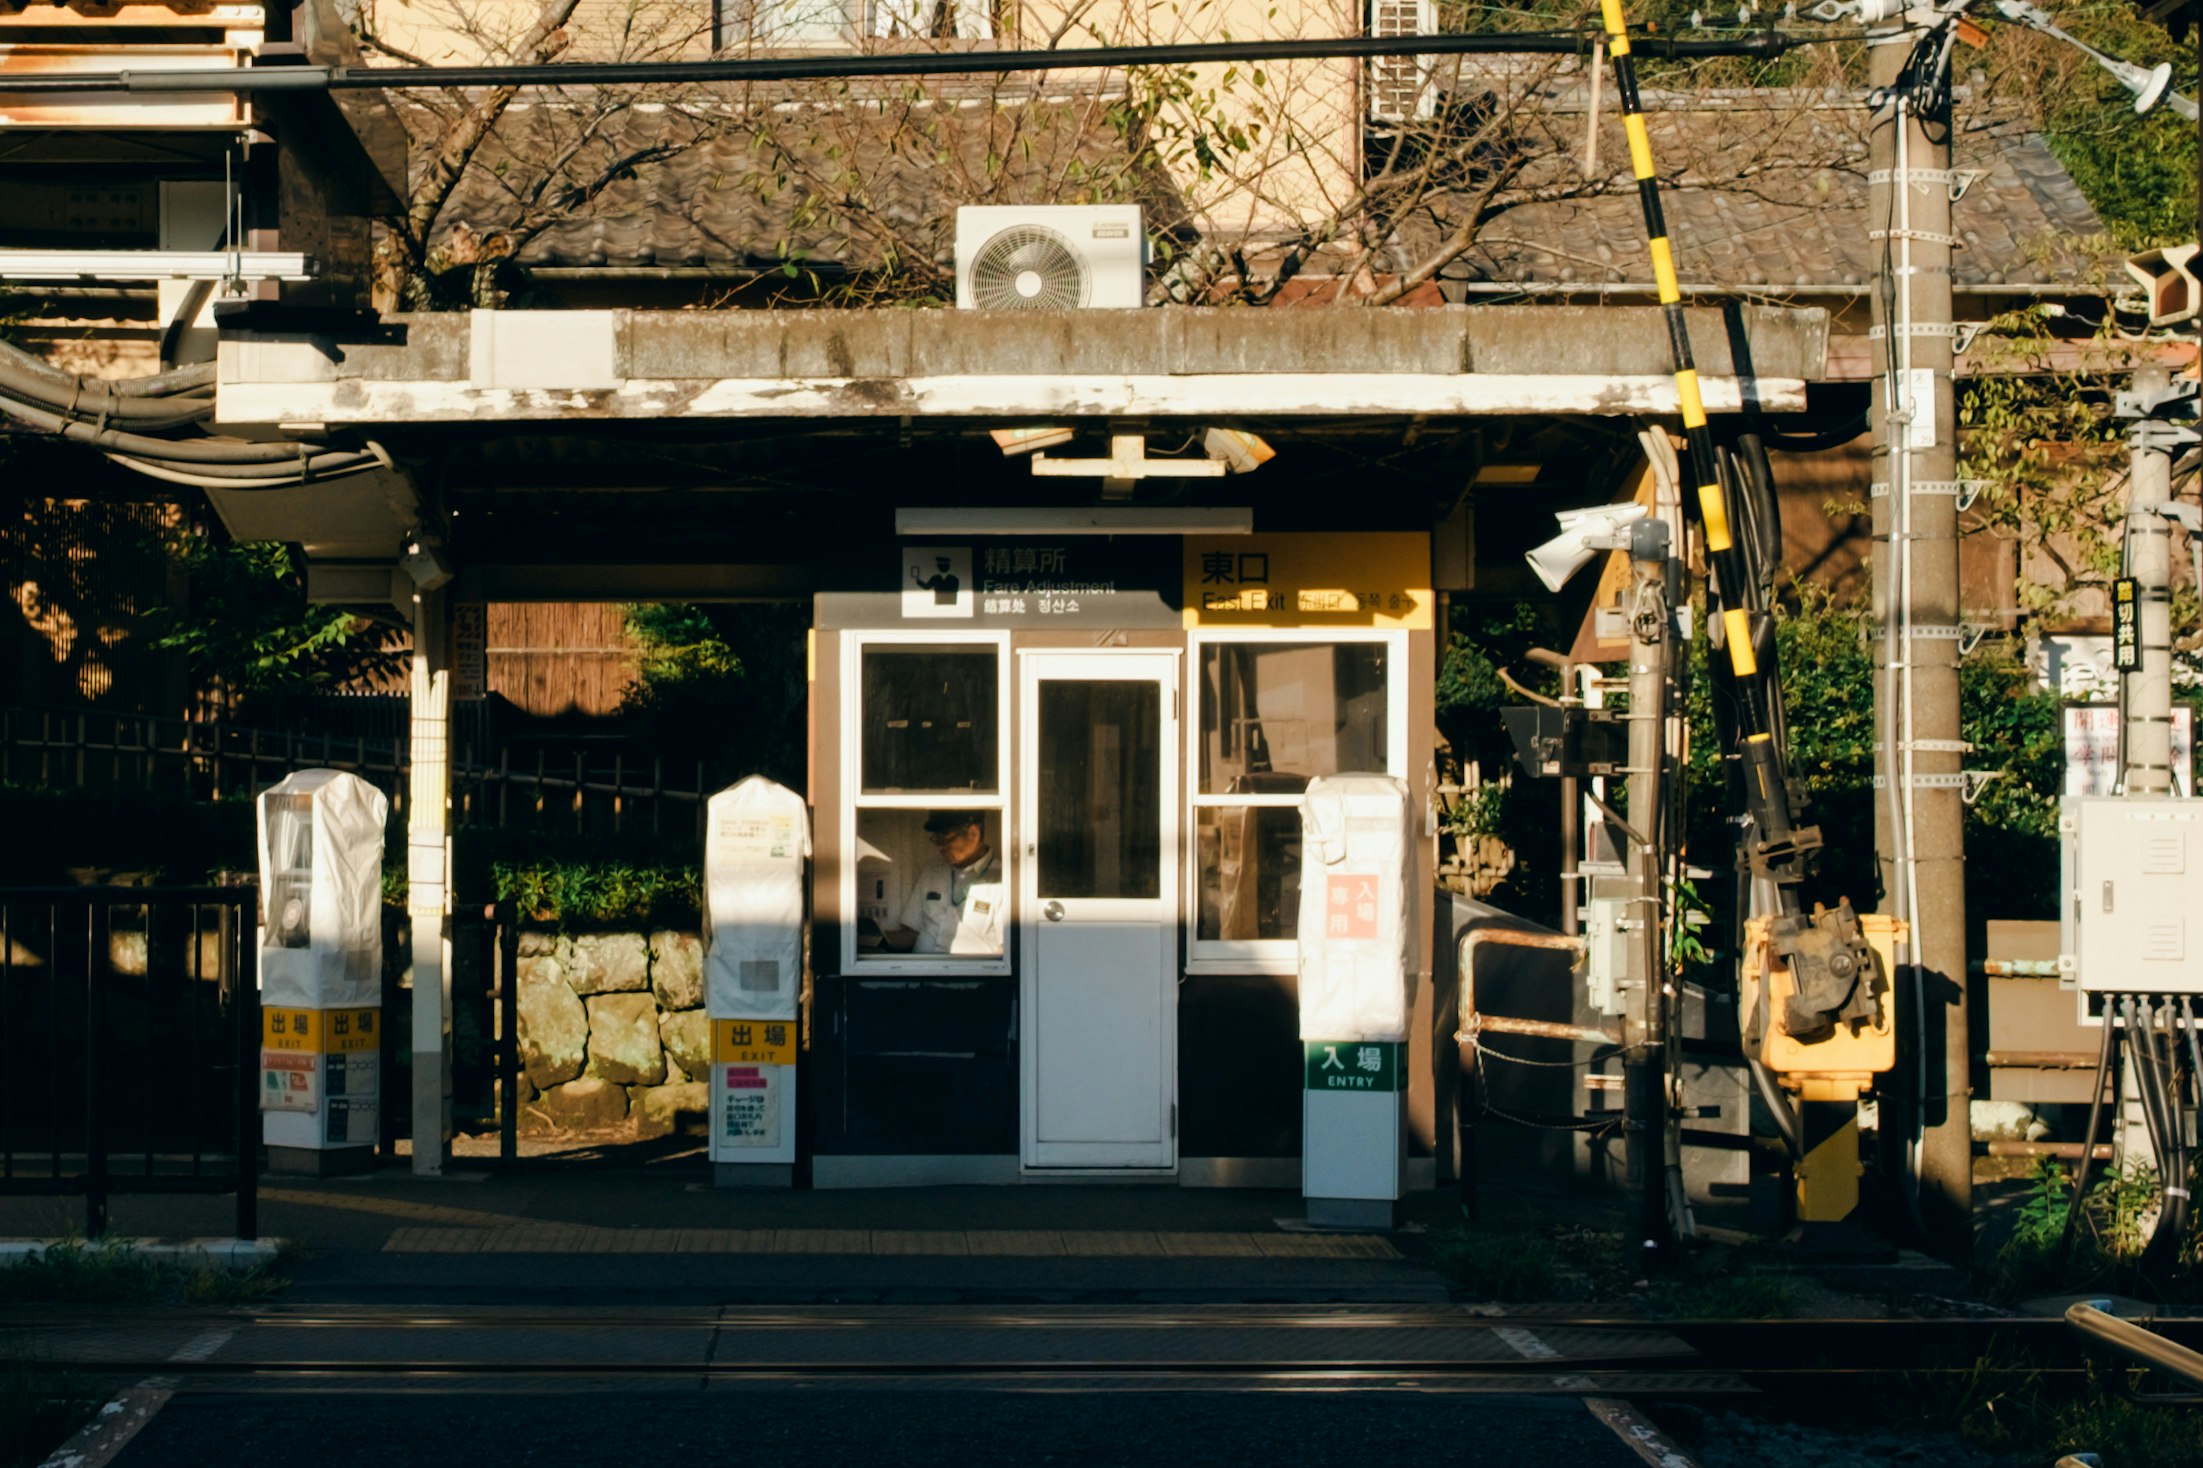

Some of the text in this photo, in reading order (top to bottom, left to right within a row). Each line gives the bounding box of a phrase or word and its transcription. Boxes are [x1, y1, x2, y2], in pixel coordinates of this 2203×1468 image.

[984, 547, 1066, 574] 精算所
[1201, 550, 1268, 584] 東口
[984, 579, 1115, 598] Fare Adjustment
[1039, 599, 1079, 613] 정산소
[1203, 591, 1285, 610] East Exit
[1330, 886, 1349, 934] 専用
[1355, 881, 1375, 922] 入場
[272, 1012, 308, 1035] 出場
[334, 1012, 373, 1035] 出場
[278, 1039, 301, 1049] EXIT
[341, 1039, 366, 1049] EXIT
[732, 1024, 786, 1046] 出場
[742, 1051, 776, 1061] EXIT
[1321, 1046, 1382, 1072] 入場
[1328, 1076, 1375, 1088] ENTRY
